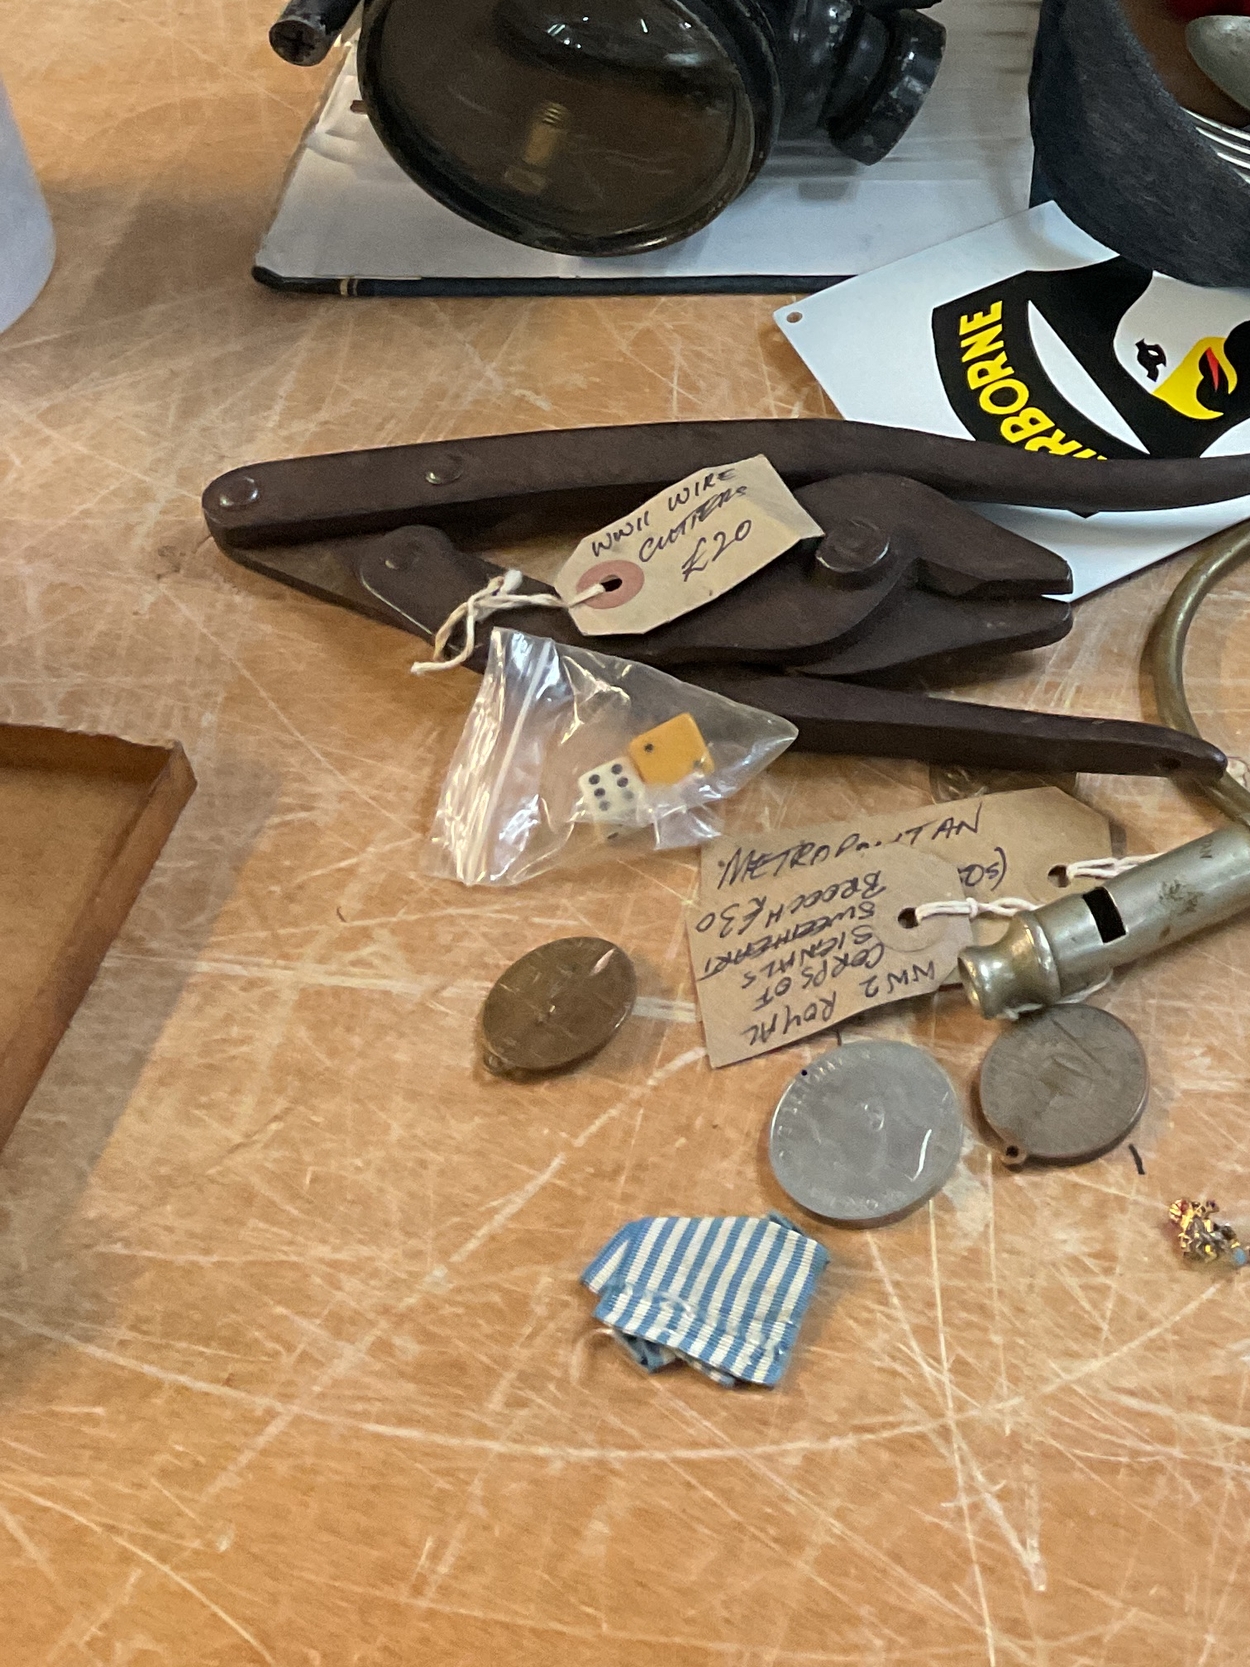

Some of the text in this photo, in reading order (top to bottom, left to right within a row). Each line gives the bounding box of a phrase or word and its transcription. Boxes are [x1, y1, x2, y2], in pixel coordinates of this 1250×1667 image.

[958, 300, 1108, 461] RBORNE
[591, 467, 737, 557] WWII WIRE
[638, 484, 749, 564] CUTTERS
[681, 519, 753, 583] £20
[694, 870, 888, 939] BROOCH £30
[697, 900, 876, 983] SWEETHEART
[741, 924, 873, 990] SIGNALS
[751, 941, 885, 1013] CORPS OF
[741, 960, 936, 1046] WW2 ROYAL
